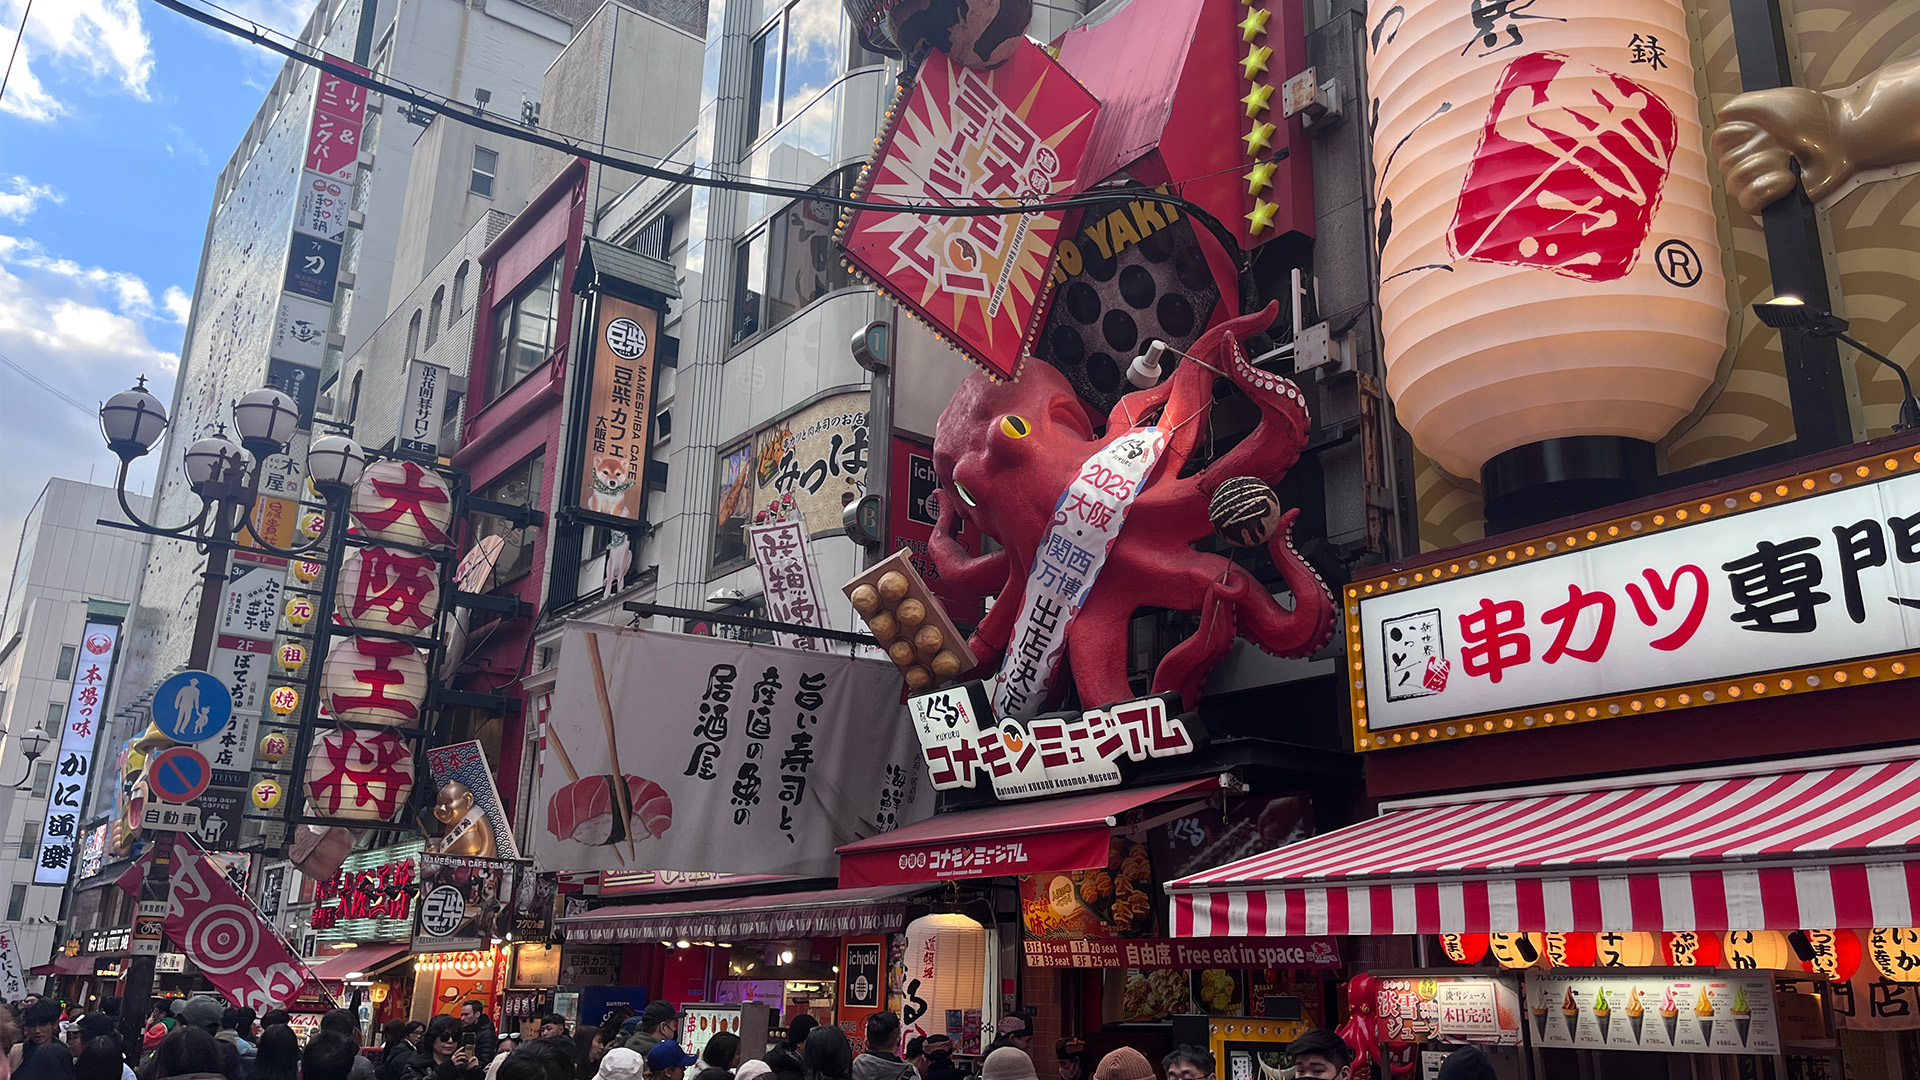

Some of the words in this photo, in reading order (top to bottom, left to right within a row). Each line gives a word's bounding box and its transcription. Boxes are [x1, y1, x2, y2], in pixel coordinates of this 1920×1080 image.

[1627, 33, 1667, 70] 録
[312, 74, 340, 171] イニングバー
[339, 170, 352, 179] 9F
[1083, 184, 1179, 260] YAKI
[312, 241, 322, 250] 7F
[303, 256, 325, 275] 刀
[413, 365, 437, 440] 浪花囲碁サロン
[609, 365, 633, 459] 豆柴カフェ
[631, 365, 647, 440] MAMESHIBA
[593, 415, 608, 454] 大阪店
[783, 412, 865, 449] 串カツと肉寿司のお店
[627, 445, 640, 481] CAFE
[1081, 463, 1136, 501] 2025
[863, 506, 877, 527] B
[1065, 492, 1117, 533] 大阪
[231, 566, 245, 576] 3F
[1045, 532, 1096, 577] 関西
[1035, 558, 1084, 602] 万博
[260, 577, 280, 632] たこやき
[236, 640, 255, 650] 2F
[308, 461, 458, 819] 大阪王将
[1000, 594, 1063, 717] 出店決定
[72, 663, 103, 738] 本場の味
[214, 654, 255, 766] ぼてぢゅう本店
[926, 693, 960, 728] くくる
[683, 664, 738, 780] 居酒屋
[935, 730, 961, 741] KUKURU
[431, 750, 481, 774] 日本一
[731, 666, 782, 826] 産直の魚の
[779, 672, 827, 844] 旨い寿司と、
[926, 706, 1188, 786] コナモンミュージアム
[996, 783, 1028, 797] Dotonbori
[1027, 779, 1054, 793] KUKURU
[1054, 770, 1119, 790] Konamon-Museum
[41, 752, 87, 870] かに道楽
[145, 809, 198, 827] 自動車
[225, 840, 235, 848] 1F
[929, 842, 1029, 869] コナモンミュージアム
[423, 857, 466, 868] MAMESHIBA
[468, 859, 487, 869] CAFE
[489, 861, 512, 870] OSAKA
[1026, 942, 1040, 952] B1F
[1042, 942, 1051, 953] 15
[1052, 943, 1068, 953] seat
[1074, 942, 1085, 952] 1F
[1089, 942, 1100, 954] 20
[1101, 943, 1118, 954] seat
[1031, 956, 1040, 966] 2F
[1044, 955, 1053, 966] 33
[1054, 956, 1071, 967] seat
[1077, 956, 1087, 966] 3F
[1092, 955, 1102, 967] 25
[1103, 957, 1121, 967] seat
[1126, 942, 1172, 966] 自由席
[1177, 944, 1211, 964] Free
[1213, 946, 1238, 964] eat
[1239, 942, 1257, 964] in
[1257, 947, 1305, 969] space
[1730, 930, 1757, 970] いか
[580, 966, 607, 976] 大阪店
[1377, 990, 1419, 1020] 淡雪
[1445, 989, 1487, 1001] 淡雪ジュース
[1387, 1017, 1445, 1041] ジュース
[1443, 1007, 1493, 1024] 本日完売
